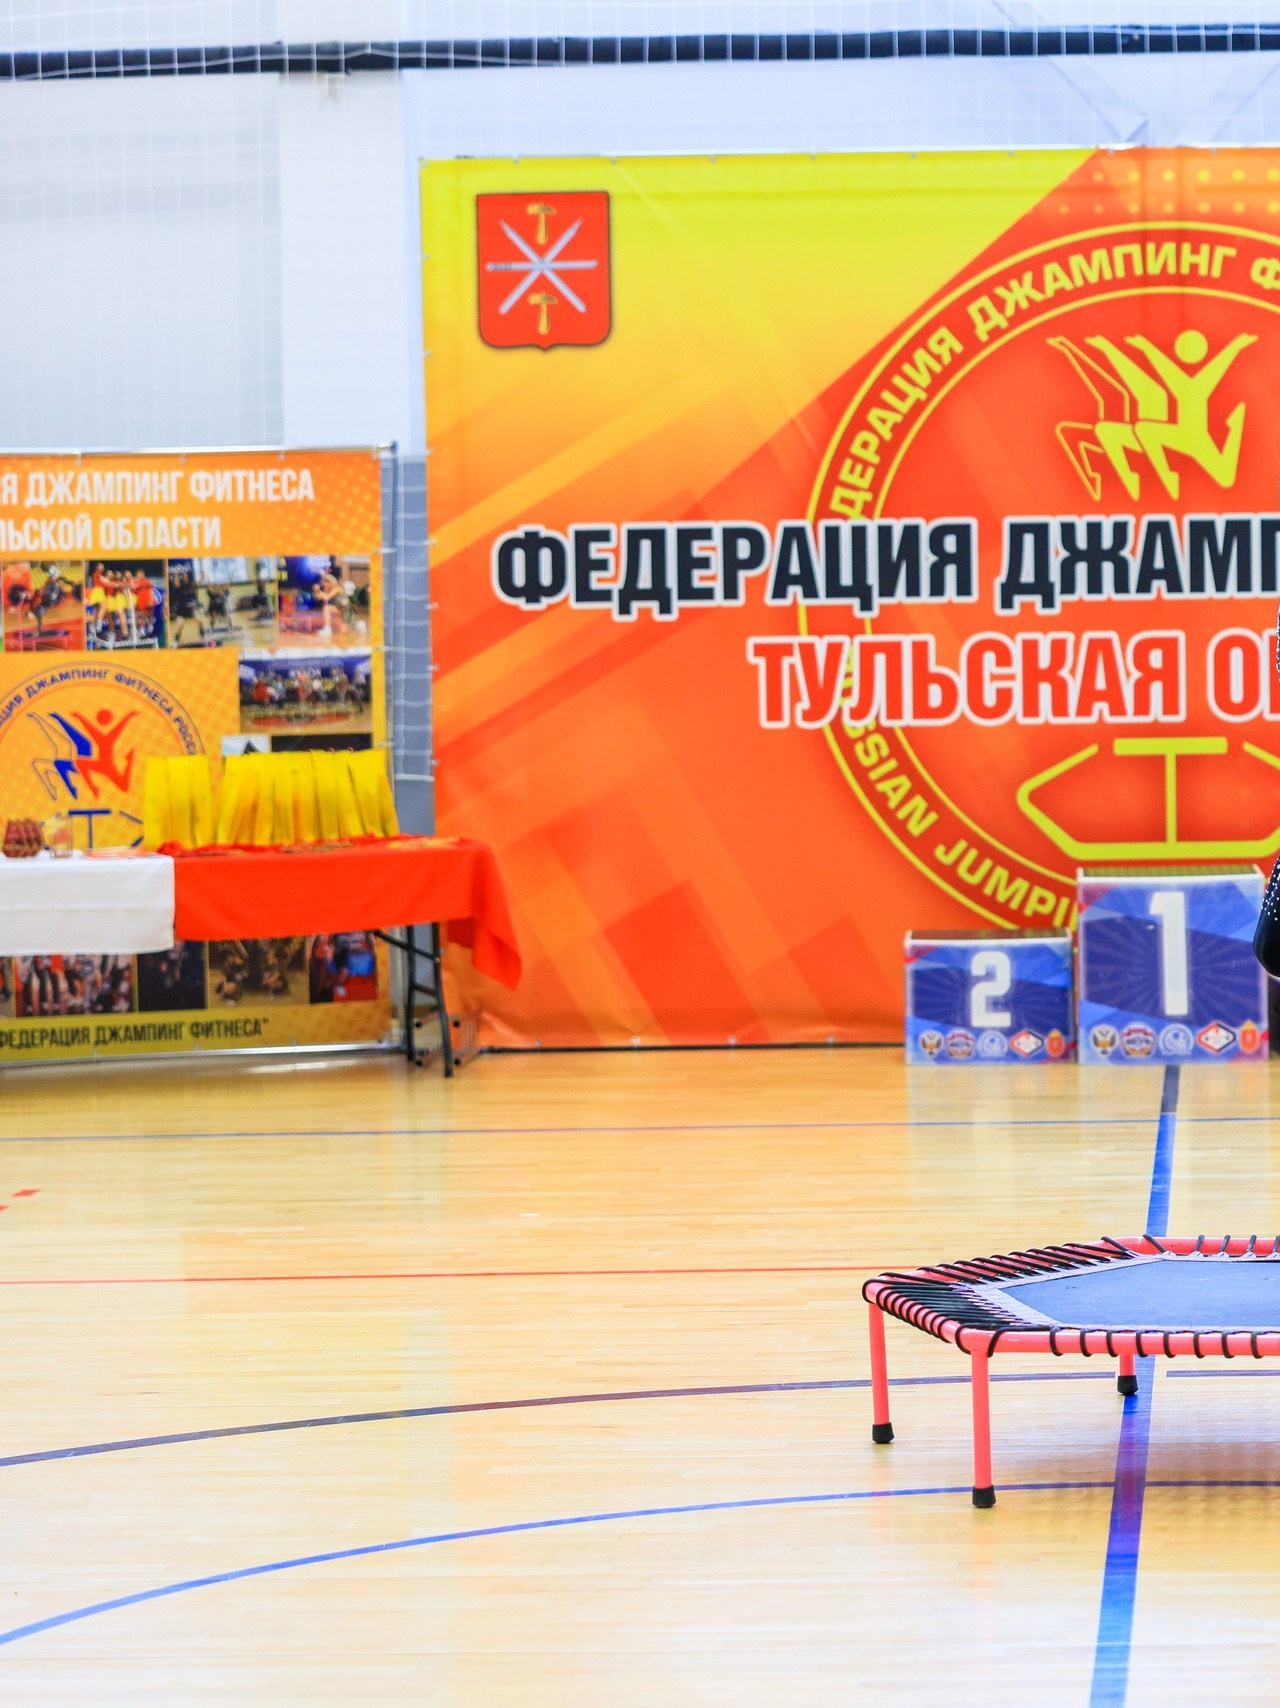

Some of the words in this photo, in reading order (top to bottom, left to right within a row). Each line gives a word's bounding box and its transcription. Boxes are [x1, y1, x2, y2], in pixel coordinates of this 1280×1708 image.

[829, 325, 965, 519] ДЕРАЦИЯ
[967, 242, 1237, 342] ДЖАМПИНГ
[24, 470, 184, 508] ДЖАМПИНГ
[189, 468, 316, 504] ФИТНЕСА
[100, 516, 222, 551] ОБЛАСТИ
[497, 521, 978, 619] ФЕДЕРАЦИЯ
[25, 668, 109, 698] ДЖАМПИНГ
[114, 672, 174, 717] ФИТНЕСА
[173, 715, 197, 755] РОСС
[749, 632, 1183, 727] ТУЛЬСКАЯ
[934, 838, 1078, 931] JUMPI
[969, 950, 1012, 1028] 2
[1149, 890, 1190, 1016] 1
[94, 1020, 187, 1046] ДЖАМПИНГ
[190, 1017, 270, 1039] ФИТНЕСА"
